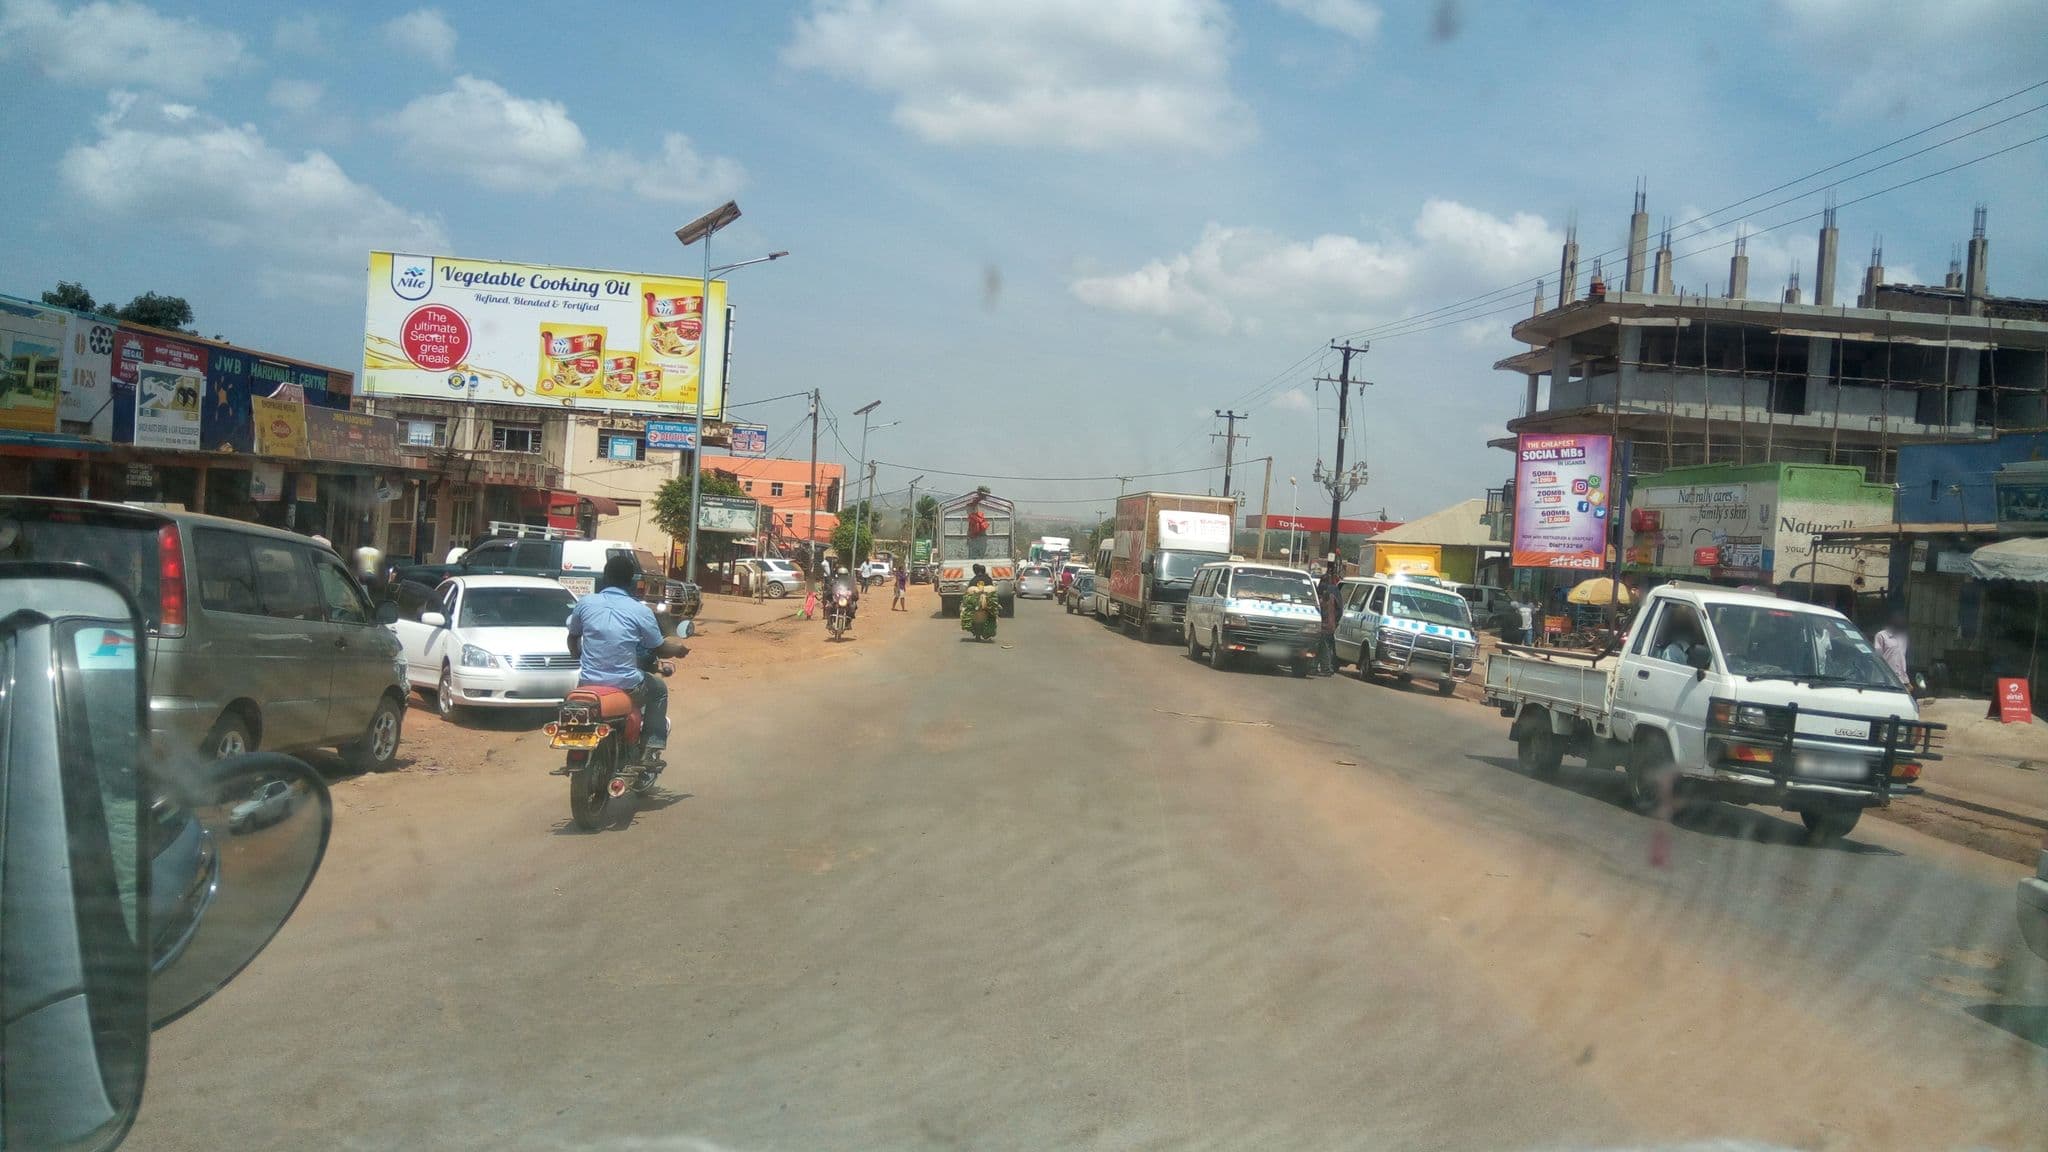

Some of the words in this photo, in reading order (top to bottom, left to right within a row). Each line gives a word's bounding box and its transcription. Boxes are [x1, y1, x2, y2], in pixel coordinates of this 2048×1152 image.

[398, 278, 425, 288] Nile
[441, 266, 525, 287] Vegetable
[530, 274, 599, 297] Cooking
[605, 279, 631, 296] Oil
[514, 296, 550, 308] Blended
[562, 300, 599, 312] Fortified
[427, 311, 447, 322] The
[414, 322, 457, 333] ultimate
[410, 331, 445, 343] Secret
[449, 335, 460, 344] to
[420, 344, 448, 354] great
[418, 354, 450, 364] meals
[215, 356, 241, 374] JWB
[301, 373, 327, 390] CENTRE
[1522, 450, 1558, 460] SOCIAL
[1561, 448, 1583, 458] MBs
[1714, 490, 1732, 502] cares
[1730, 503, 1747, 519] skin
[1278, 520, 1305, 528] TOTAL
[1785, 545, 1805, 553] your
[1550, 555, 1599, 568] africell
